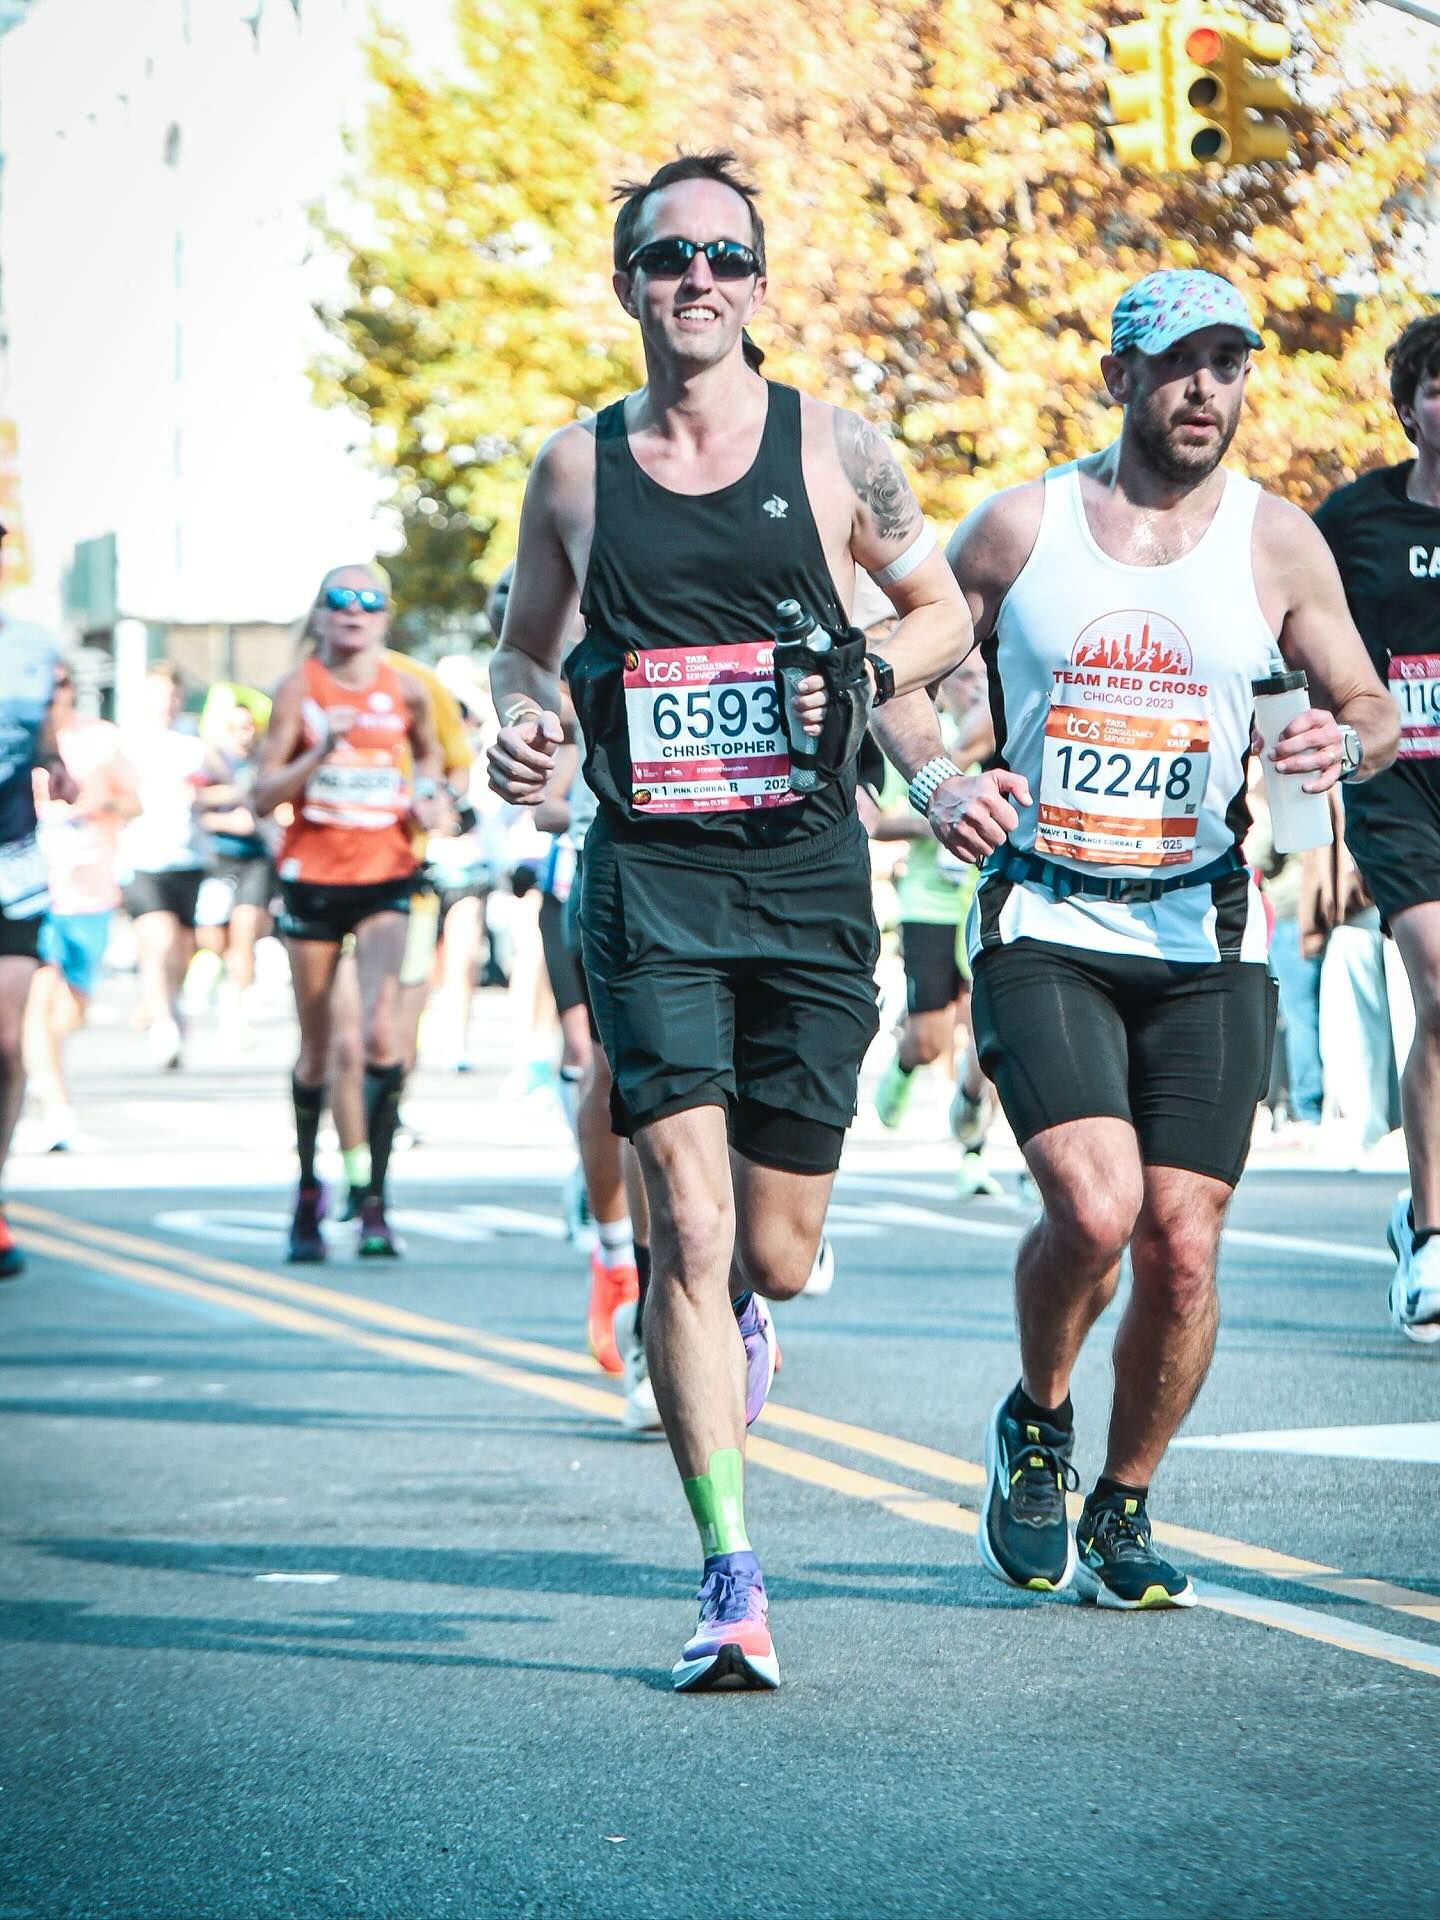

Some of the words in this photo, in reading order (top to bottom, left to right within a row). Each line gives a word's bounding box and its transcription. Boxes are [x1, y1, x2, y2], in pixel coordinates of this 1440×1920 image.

[685, 655, 708, 663] TATA
[644, 658, 683, 682] tcs
[685, 661, 740, 673] CONSULTANCY
[753, 667, 775, 675] TAT
[685, 671, 721, 680] SERVICES
[1053, 671, 1101, 687] TEAM
[1107, 676, 1143, 691] RED
[1149, 680, 1208, 697] CROSS
[1083, 691, 1143, 707] CHICAGO
[1145, 697, 1174, 710] 2023
[653, 686, 781, 740] 6593
[1066, 712, 1100, 740] tcs
[1105, 718, 1127, 728] TATA
[1104, 726, 1155, 739] CONSULTANCY
[1103, 734, 1136, 745] SERVICES
[1166, 738, 1191, 748] TATA
[662, 740, 776, 758] CHRISTOPHER
[1057, 745, 1192, 800] 12248
[661, 786, 668, 796] 1
[693, 784, 728, 793] CORRAL
[729, 782, 739, 793] B
[1040, 827, 1060, 837] WAVE
[1062, 830, 1068, 840] 1
[1104, 838, 1133, 848] CORRAL
[1135, 840, 1143, 849] E
[1155, 839, 1183, 850] 2025
